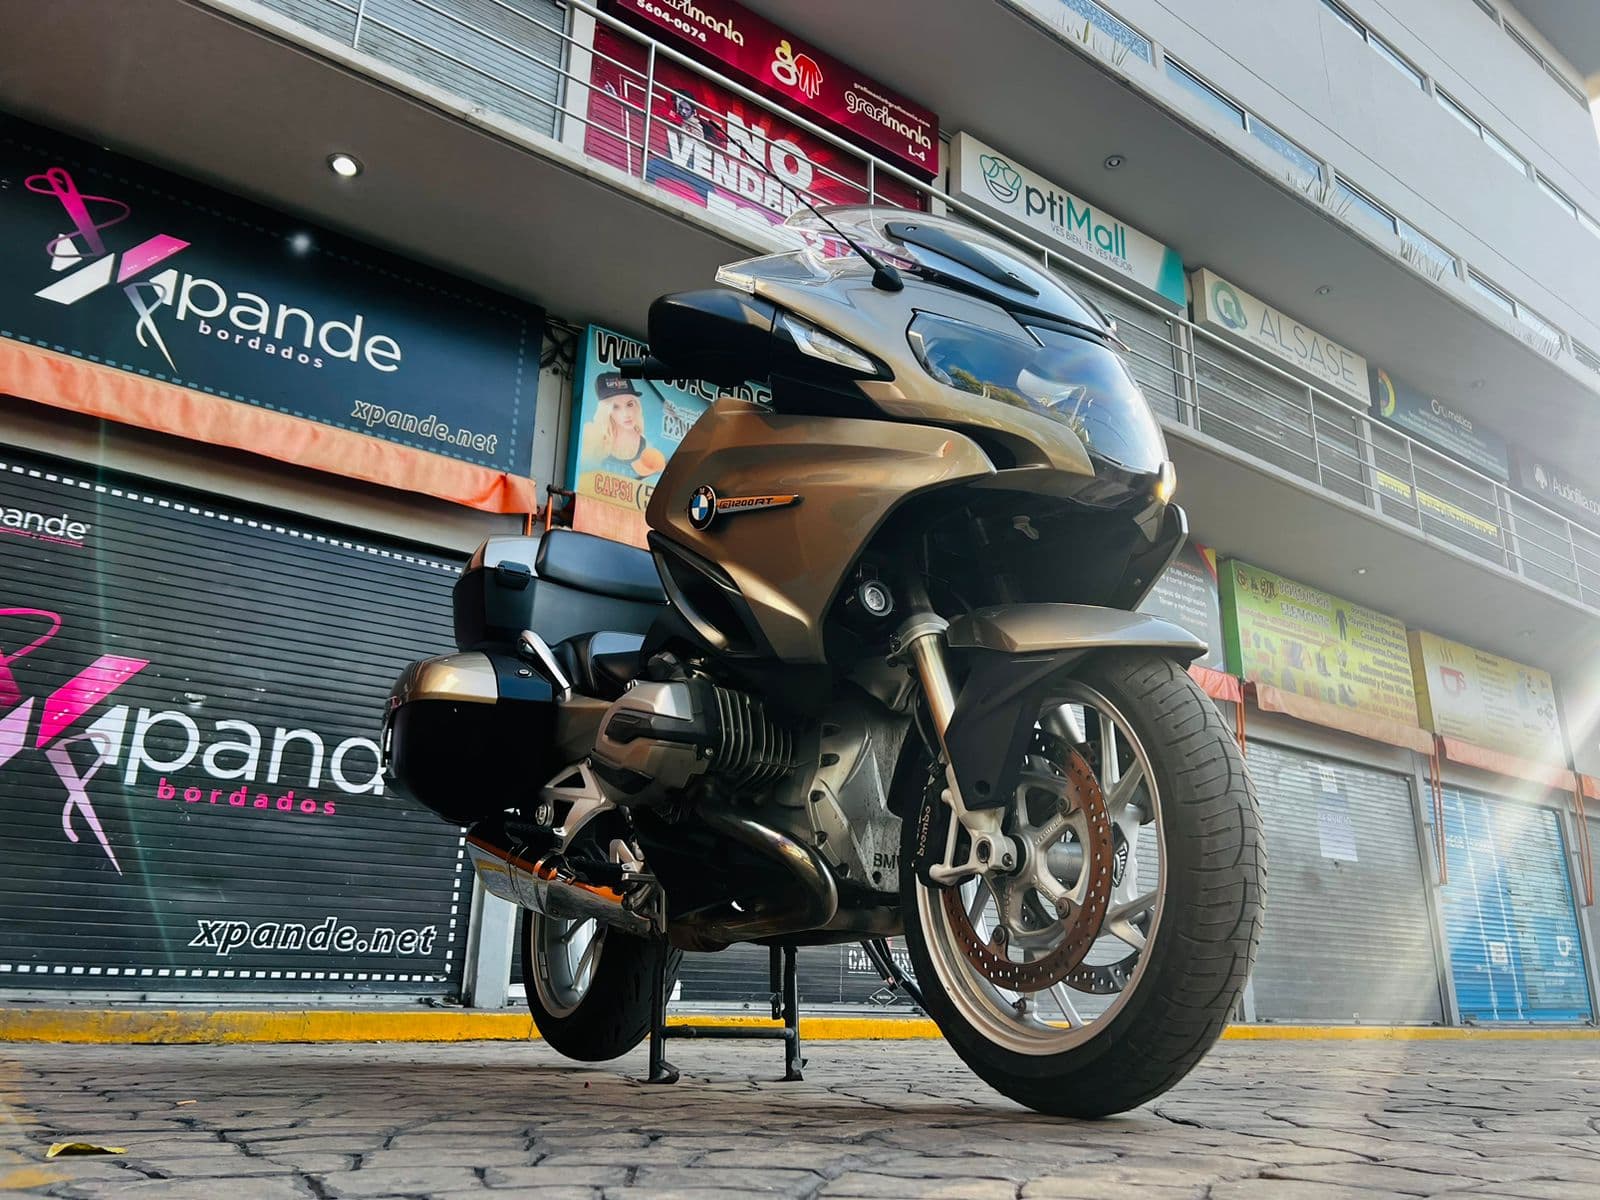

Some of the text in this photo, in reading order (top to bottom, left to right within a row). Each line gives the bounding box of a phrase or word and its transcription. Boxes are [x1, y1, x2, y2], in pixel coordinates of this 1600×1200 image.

[727, 111, 813, 191] NO
[199, 320, 324, 369] bordados
[1260, 309, 1357, 386] ALSASE
[351, 399, 498, 455] xpande.net
[0, 508, 87, 540] ande
[156, 777, 337, 816] bordados
[189, 915, 438, 956] xpande.net
